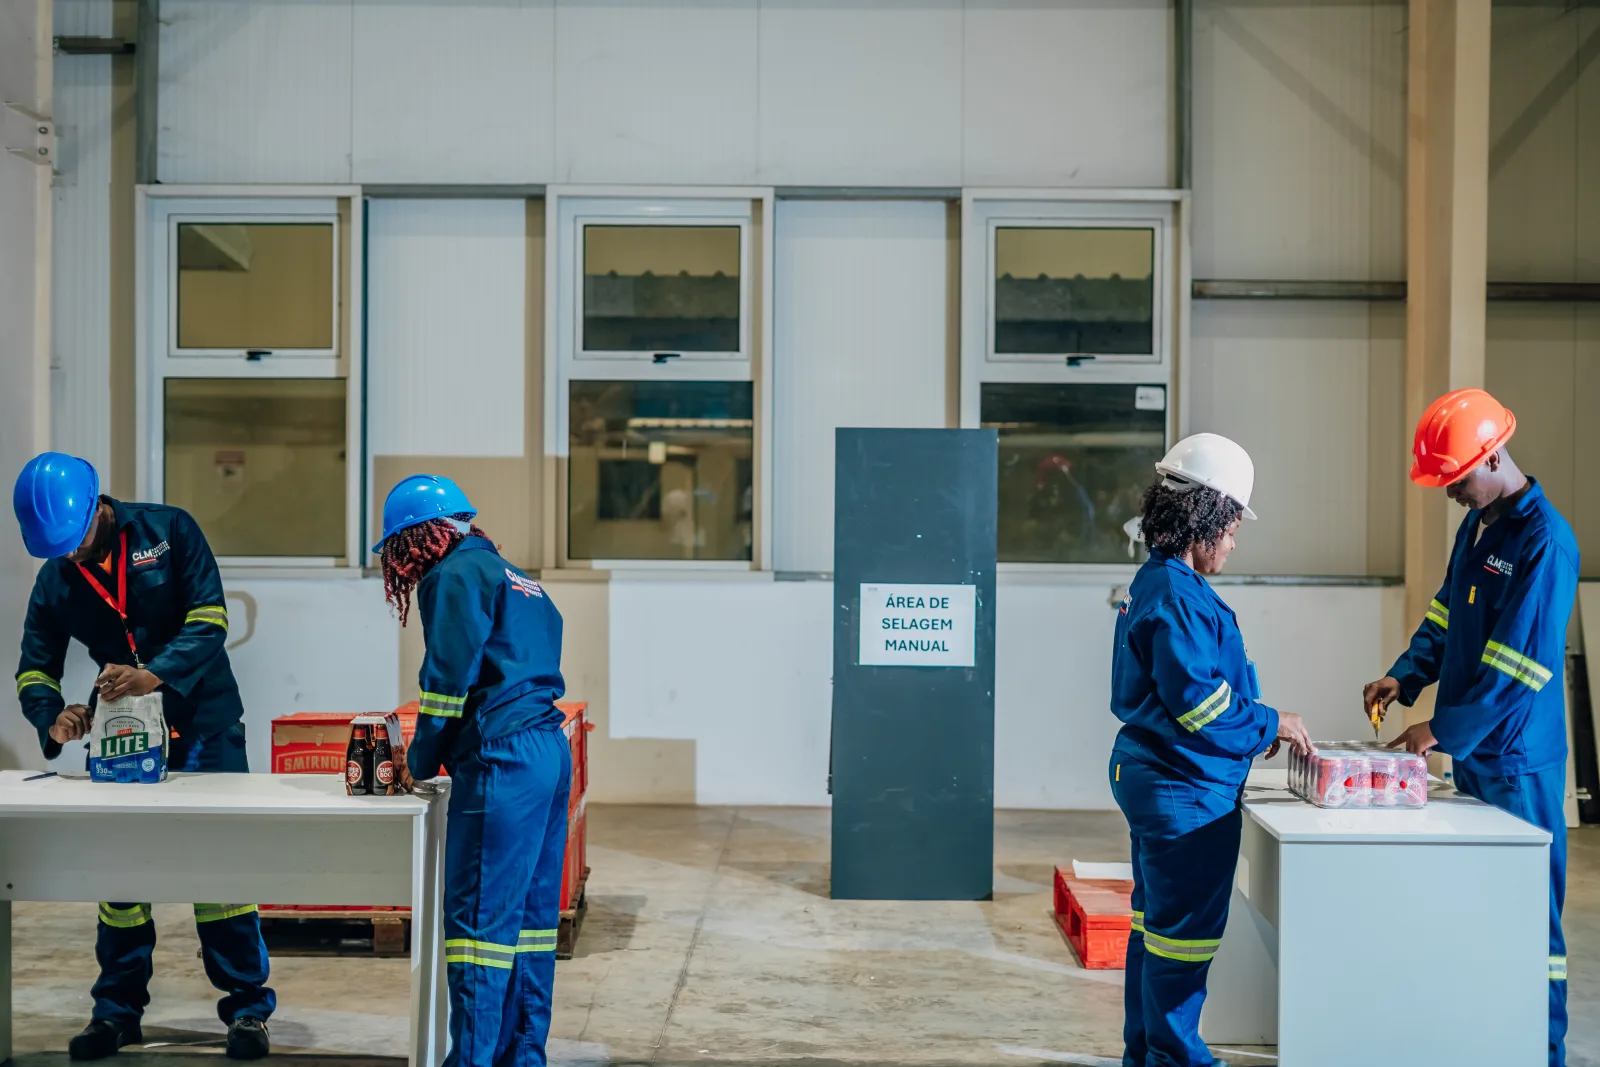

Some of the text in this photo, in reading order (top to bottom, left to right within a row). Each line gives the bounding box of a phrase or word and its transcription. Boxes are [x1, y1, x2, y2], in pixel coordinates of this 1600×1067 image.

[132, 549, 153, 561] CLM
[885, 593, 949, 609] ÁREA DE
[881, 617, 953, 631] SELAGEM
[885, 639, 949, 652] MANUAL
[105, 734, 144, 758] LITE
[284, 755, 346, 771] SMIRNOF
